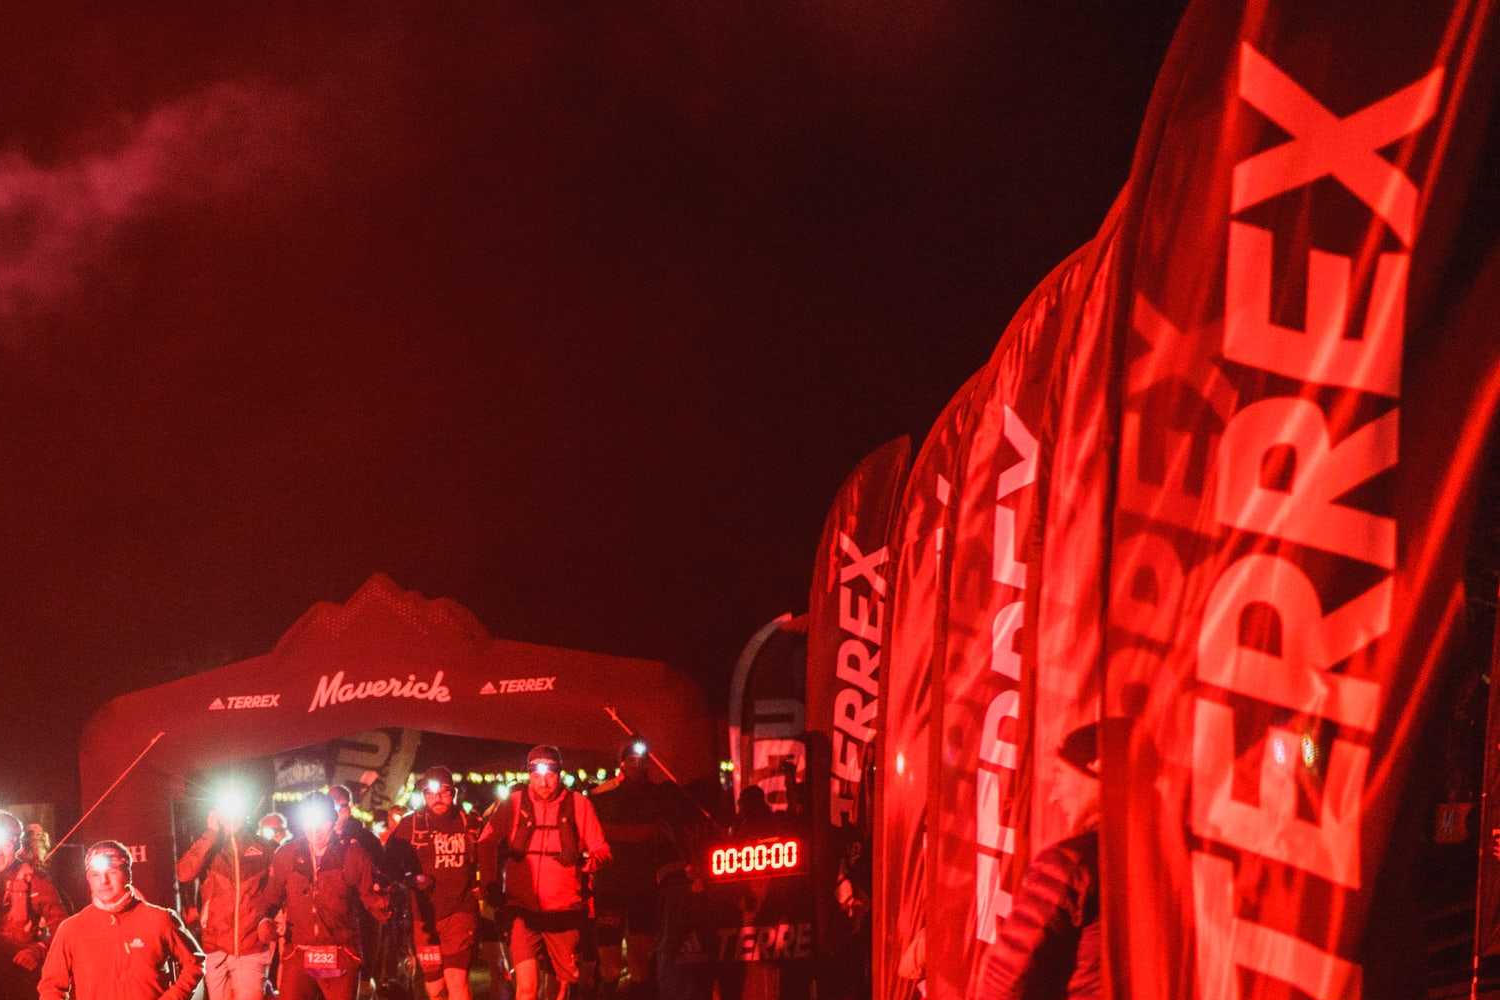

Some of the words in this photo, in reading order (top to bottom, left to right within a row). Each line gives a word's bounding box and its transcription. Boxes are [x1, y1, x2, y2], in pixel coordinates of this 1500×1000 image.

[499, 677, 556, 693] TERREX
[830, 532, 890, 828] TERREX
[308, 670, 451, 713] Maverick
[227, 694, 281, 709] TERREX
[435, 854, 465, 869] PRJ
[712, 841, 797, 875] 00:00:00
[716, 923, 812, 962] TERRE
[307, 952, 335, 964] 1232
[419, 952, 441, 962] 1418
